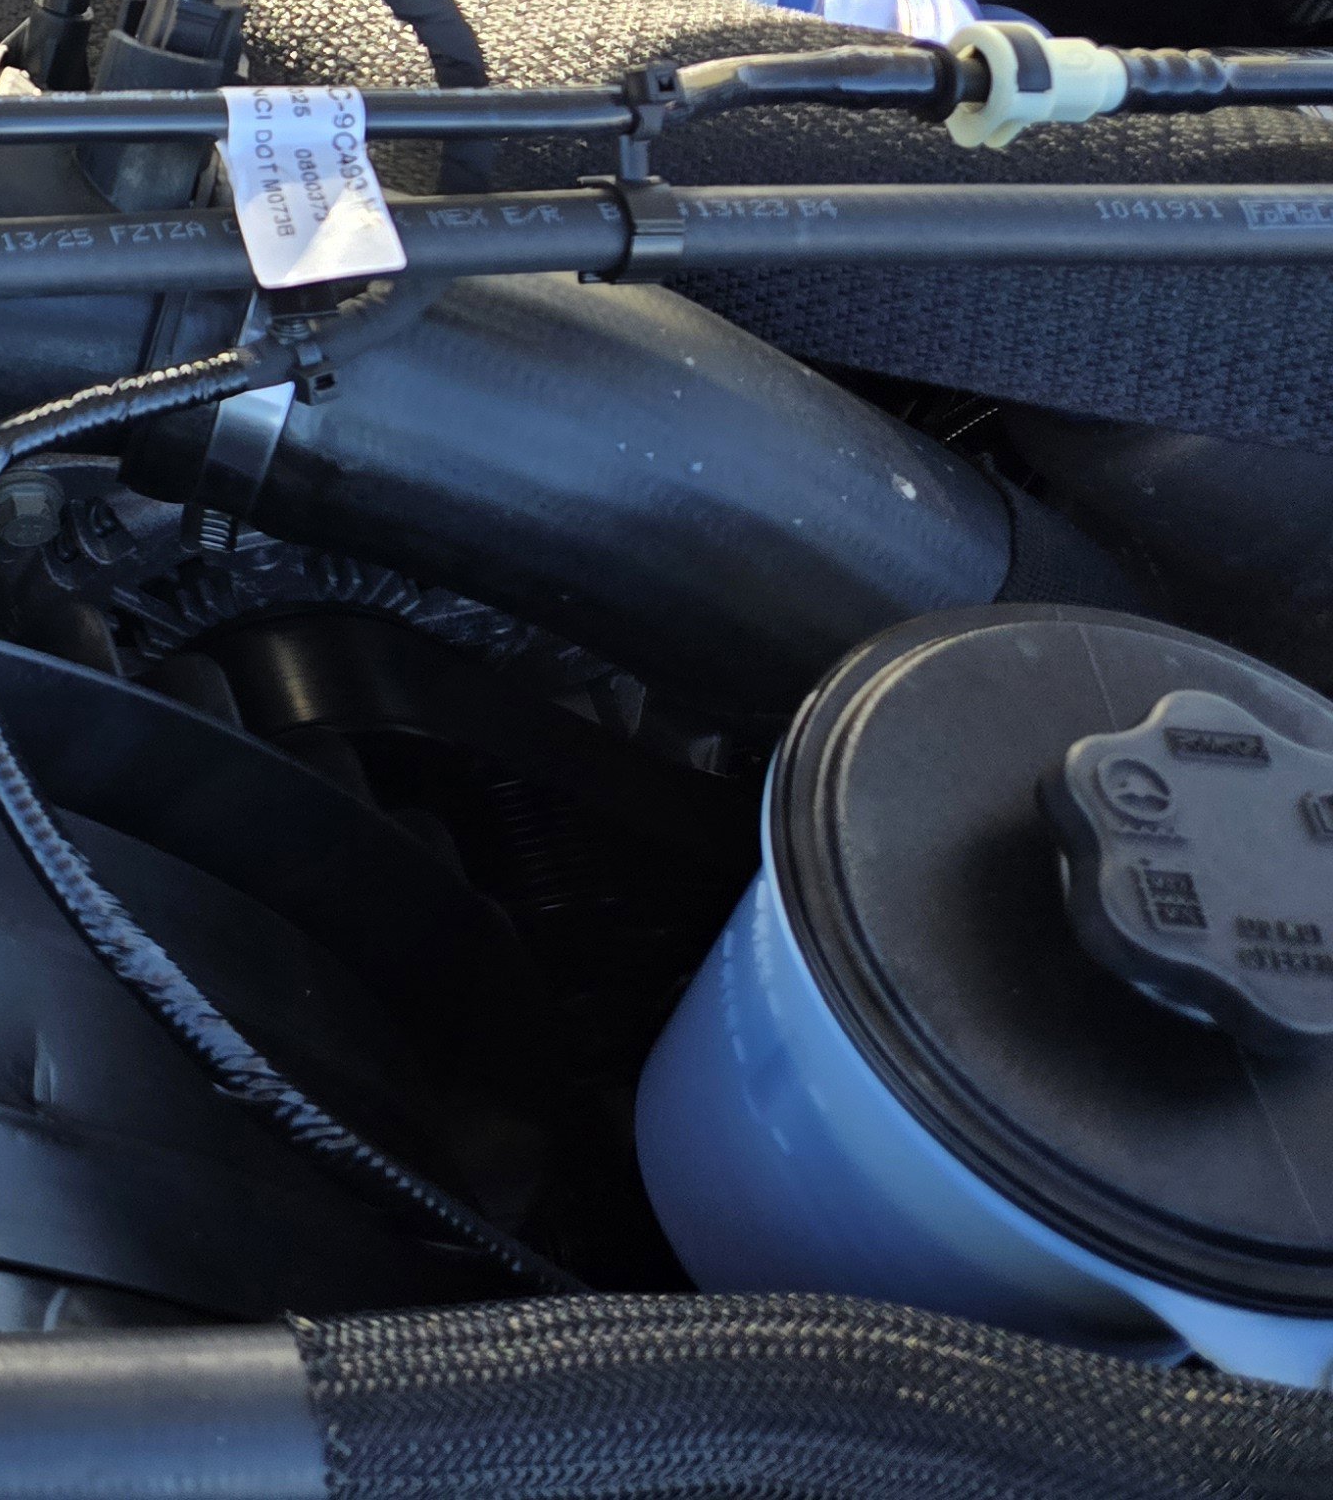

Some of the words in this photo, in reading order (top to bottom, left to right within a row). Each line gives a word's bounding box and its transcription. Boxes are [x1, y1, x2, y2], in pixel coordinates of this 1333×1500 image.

[254, 130, 278, 171] DOT
[426, 205, 489, 229] MEX
[1094, 199, 1225, 221] 1041911
[1248, 201, 1333, 223] FoMoC
